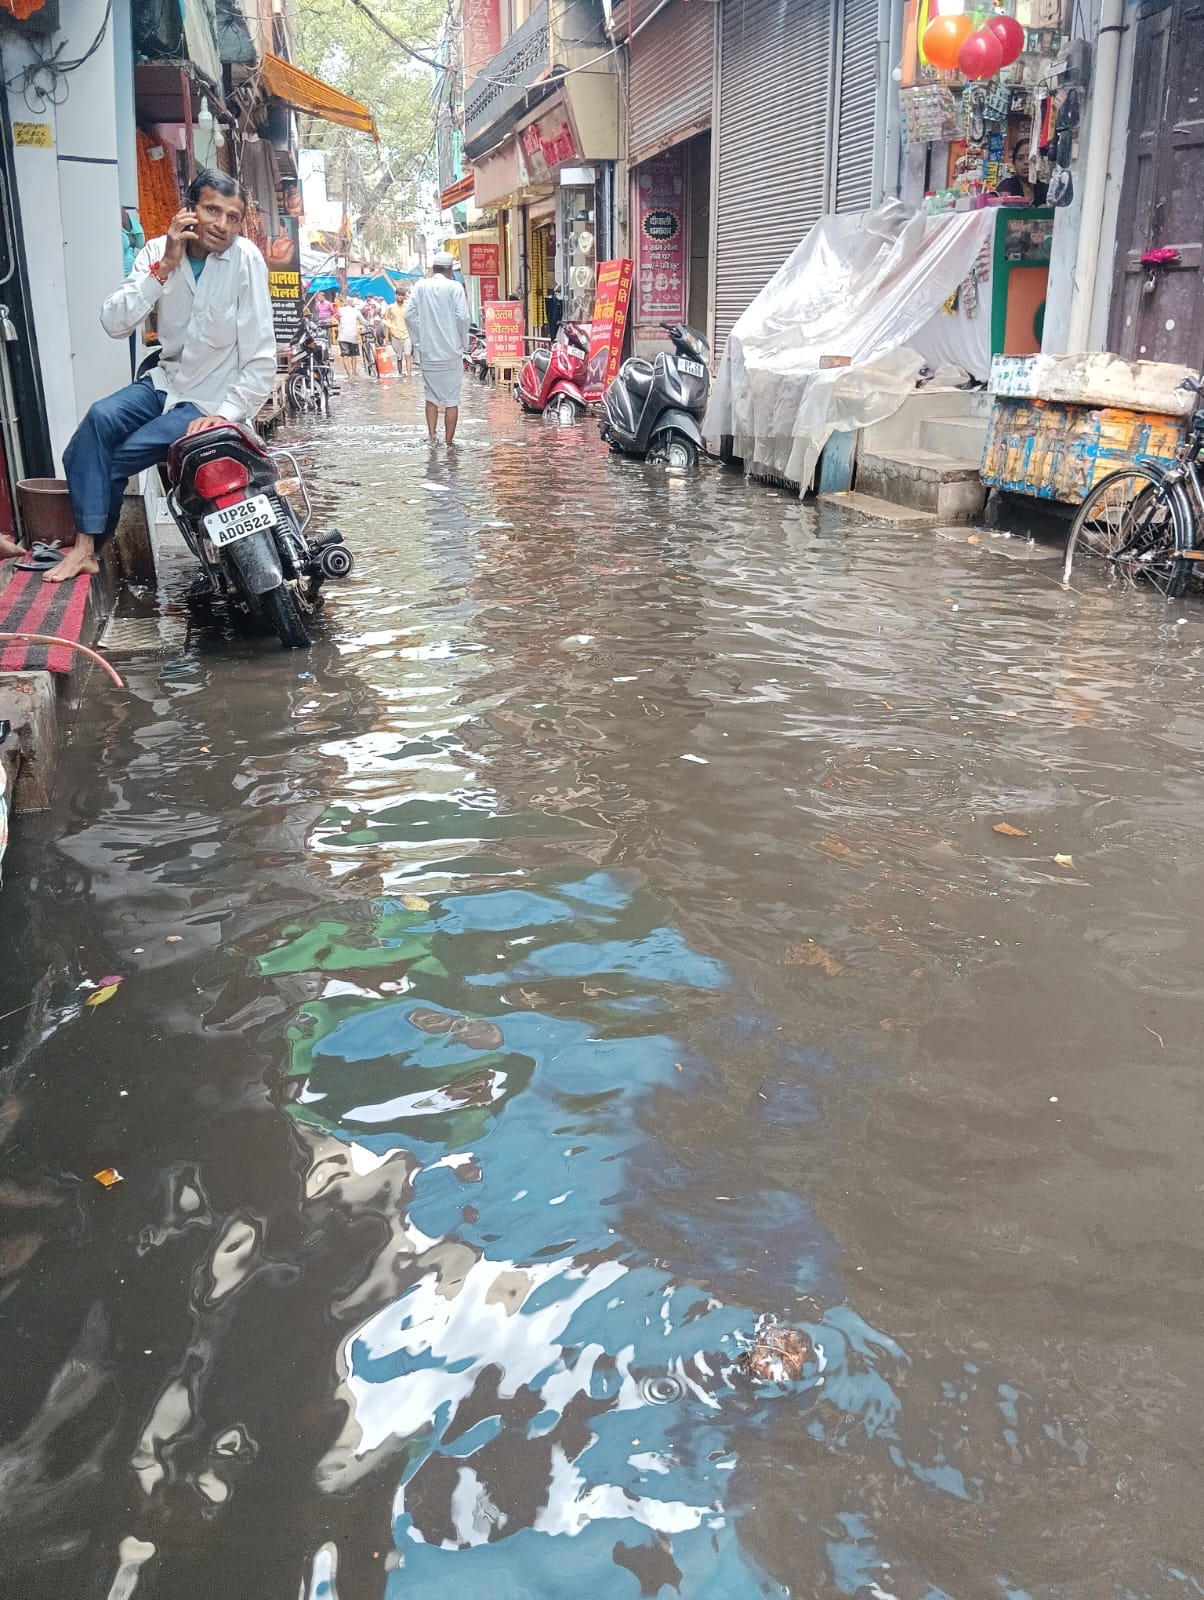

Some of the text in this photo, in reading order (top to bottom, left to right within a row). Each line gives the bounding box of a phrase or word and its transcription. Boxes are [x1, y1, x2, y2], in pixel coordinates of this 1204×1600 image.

[495, 309, 513, 320] उत्तम
[218, 502, 257, 524] UP26
[218, 513, 271, 543] AD0522
